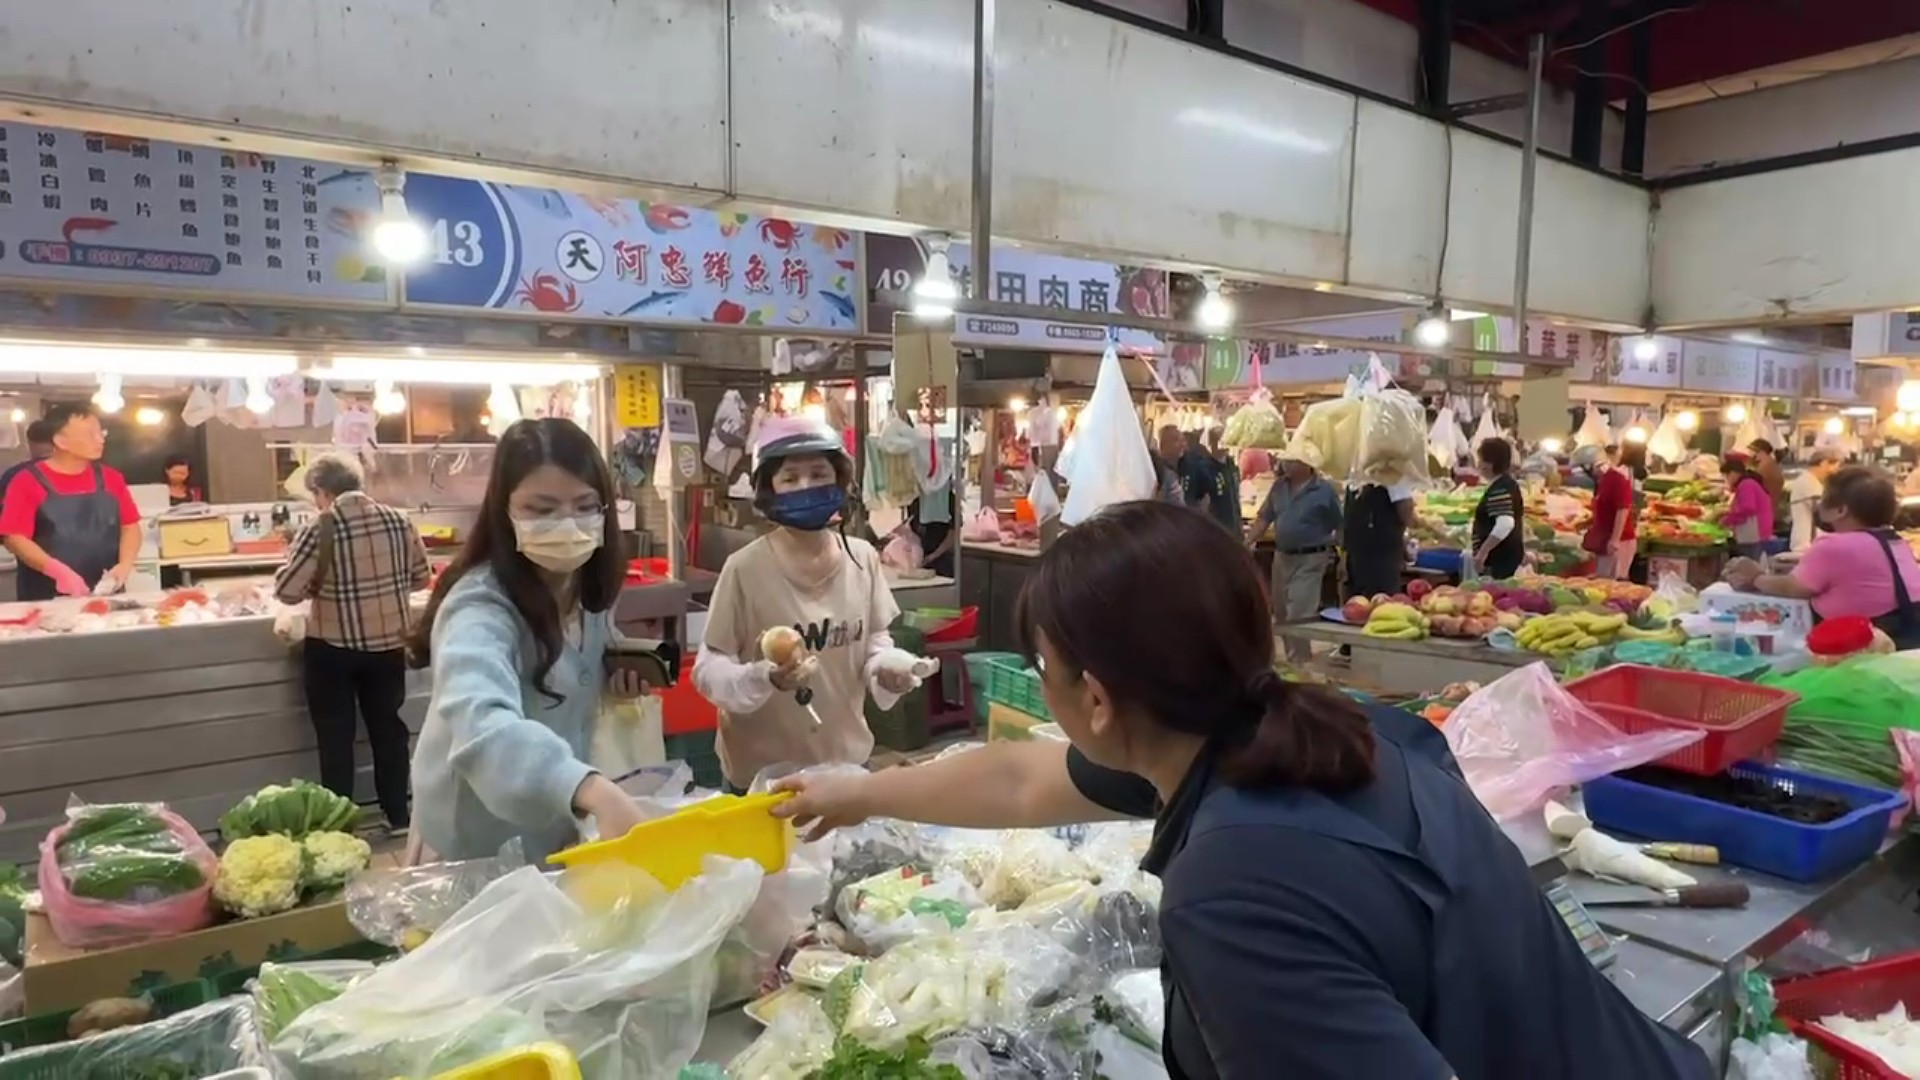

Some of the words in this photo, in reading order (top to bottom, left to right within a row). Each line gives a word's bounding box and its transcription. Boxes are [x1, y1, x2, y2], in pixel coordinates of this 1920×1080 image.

[430, 217, 485, 268] 43
[564, 237, 600, 274] 天
[612, 238, 813, 299] 阿忠鮮魚行
